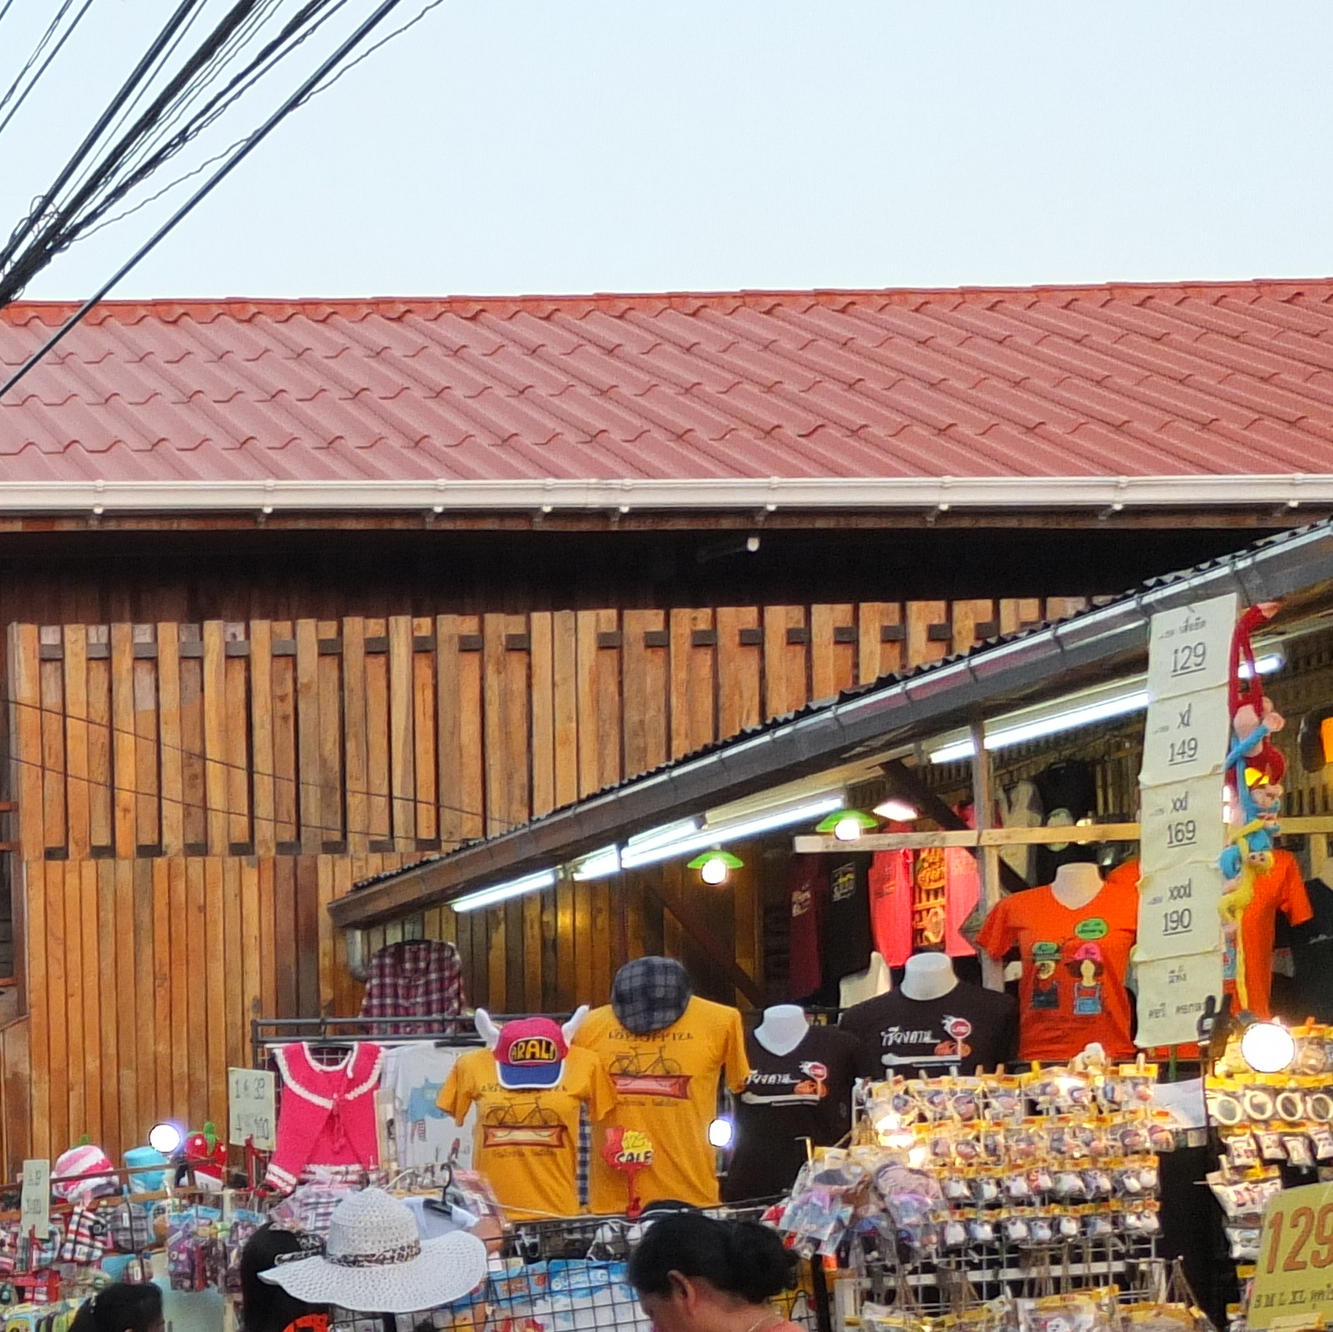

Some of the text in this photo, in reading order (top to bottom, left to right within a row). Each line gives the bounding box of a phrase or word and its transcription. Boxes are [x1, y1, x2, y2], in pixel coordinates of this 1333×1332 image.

[1171, 641, 1206, 673] 129
[1168, 737, 1198, 763] 149
[1166, 820, 1196, 846] 169
[1163, 908, 1192, 935] 190
[1266, 1203, 1333, 1274] 129
